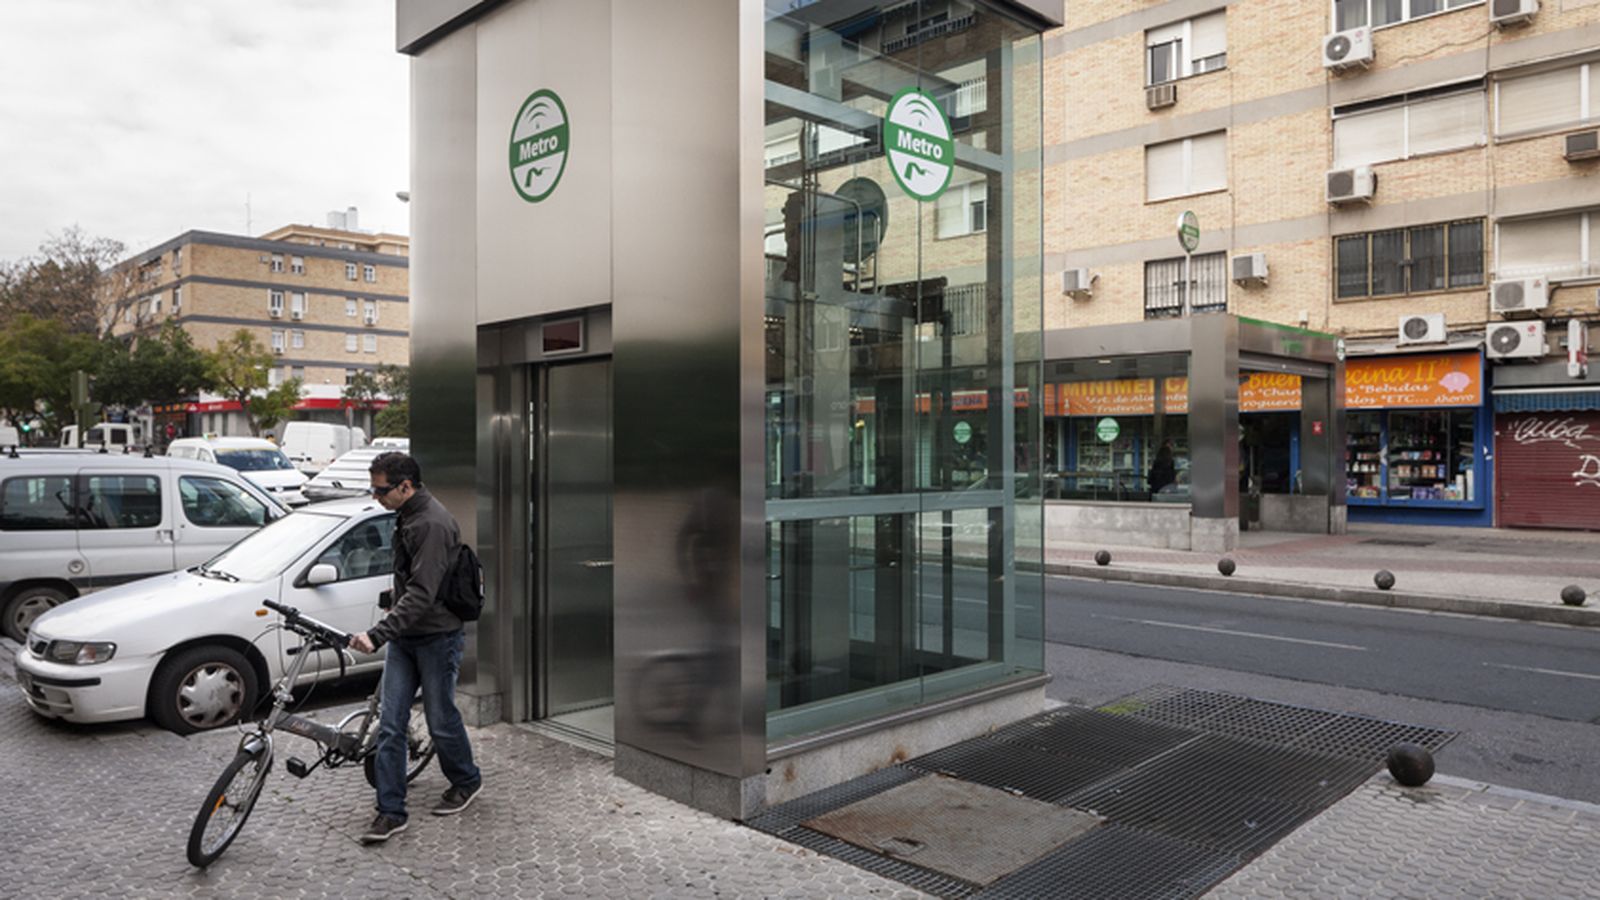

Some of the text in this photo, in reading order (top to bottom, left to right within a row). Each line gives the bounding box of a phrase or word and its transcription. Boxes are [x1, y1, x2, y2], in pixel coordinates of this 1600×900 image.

[519, 135, 558, 162] Metro
[898, 128, 943, 160] Metro
[1249, 373, 1302, 389] Buen
[1345, 365, 1410, 385] ecina
